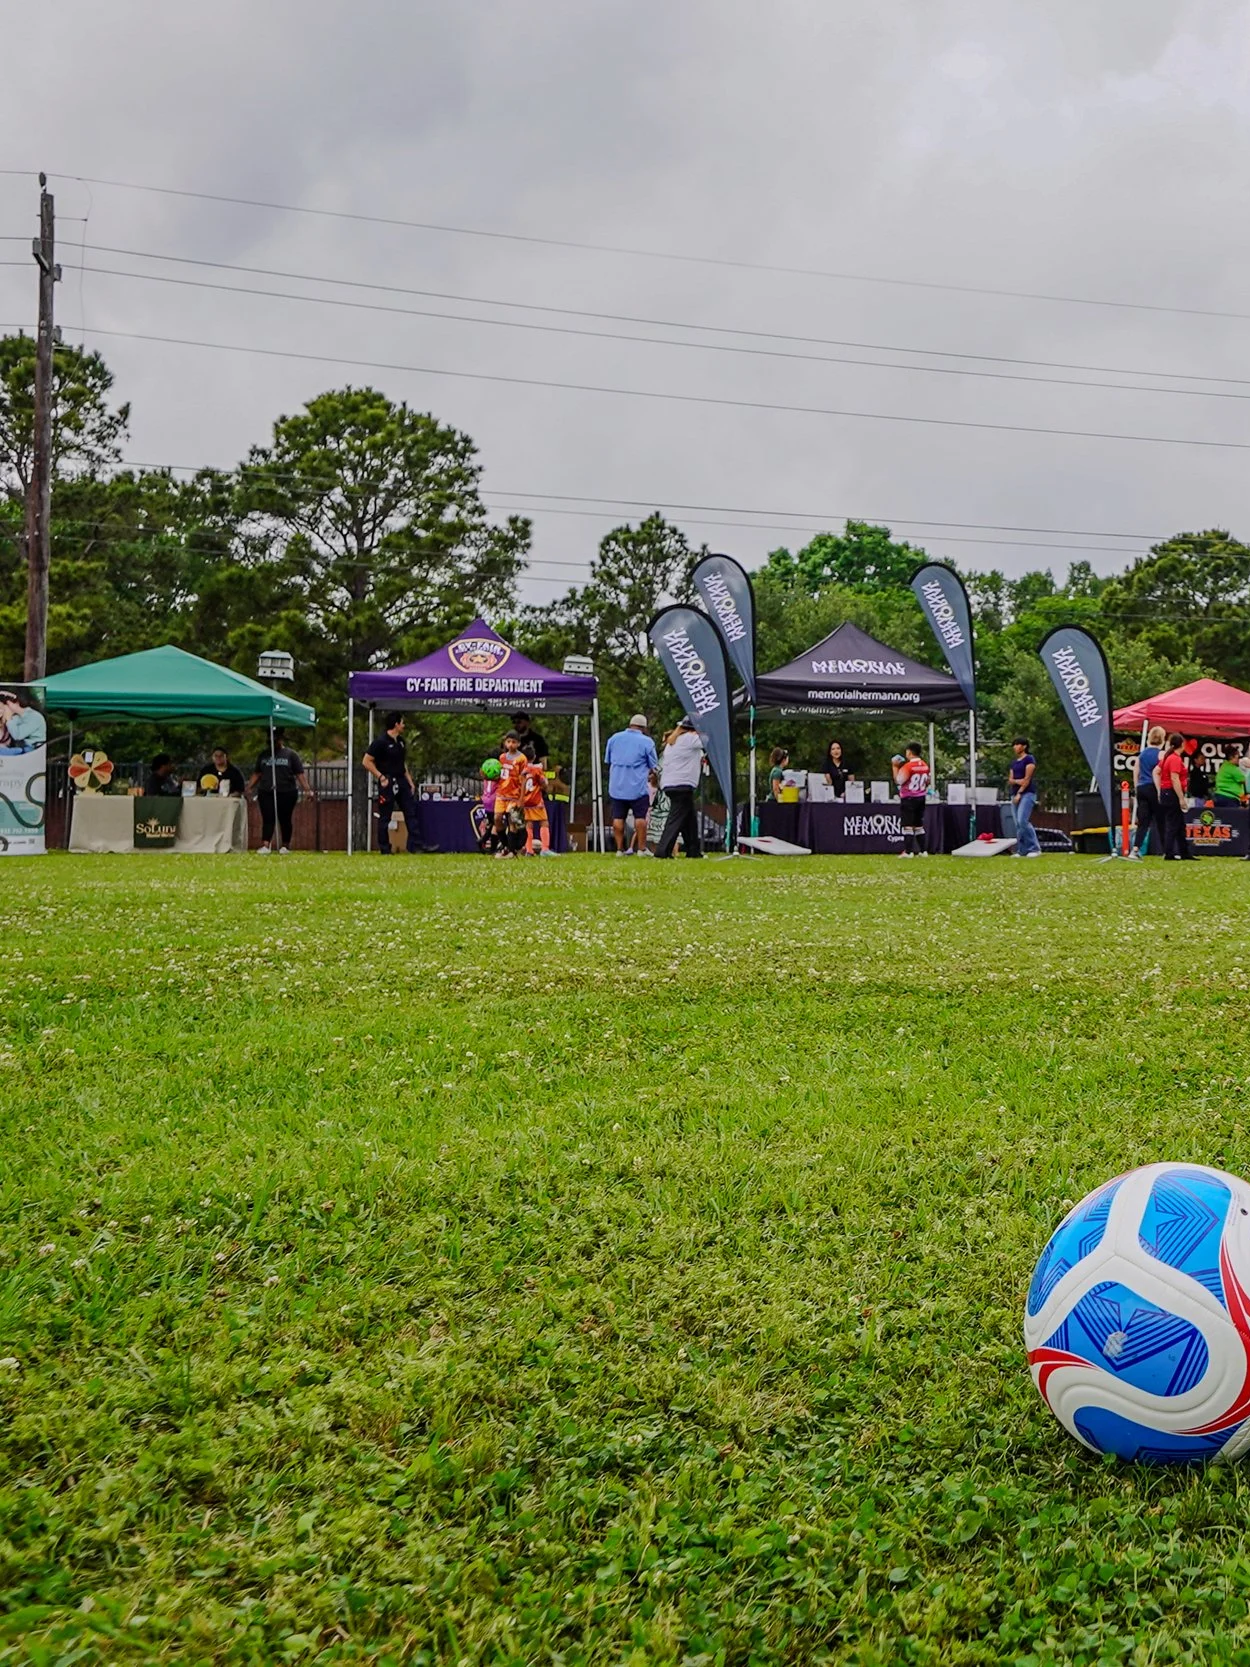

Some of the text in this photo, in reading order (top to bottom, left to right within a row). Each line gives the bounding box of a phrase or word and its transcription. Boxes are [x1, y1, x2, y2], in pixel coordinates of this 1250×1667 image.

[406, 678, 544, 693] CY-FAIR FIRE DEPARTMENT
[808, 689, 921, 703] memorialhermann.org
[844, 814, 902, 827] MEMORI
[1185, 825, 1231, 838] TEXAS
